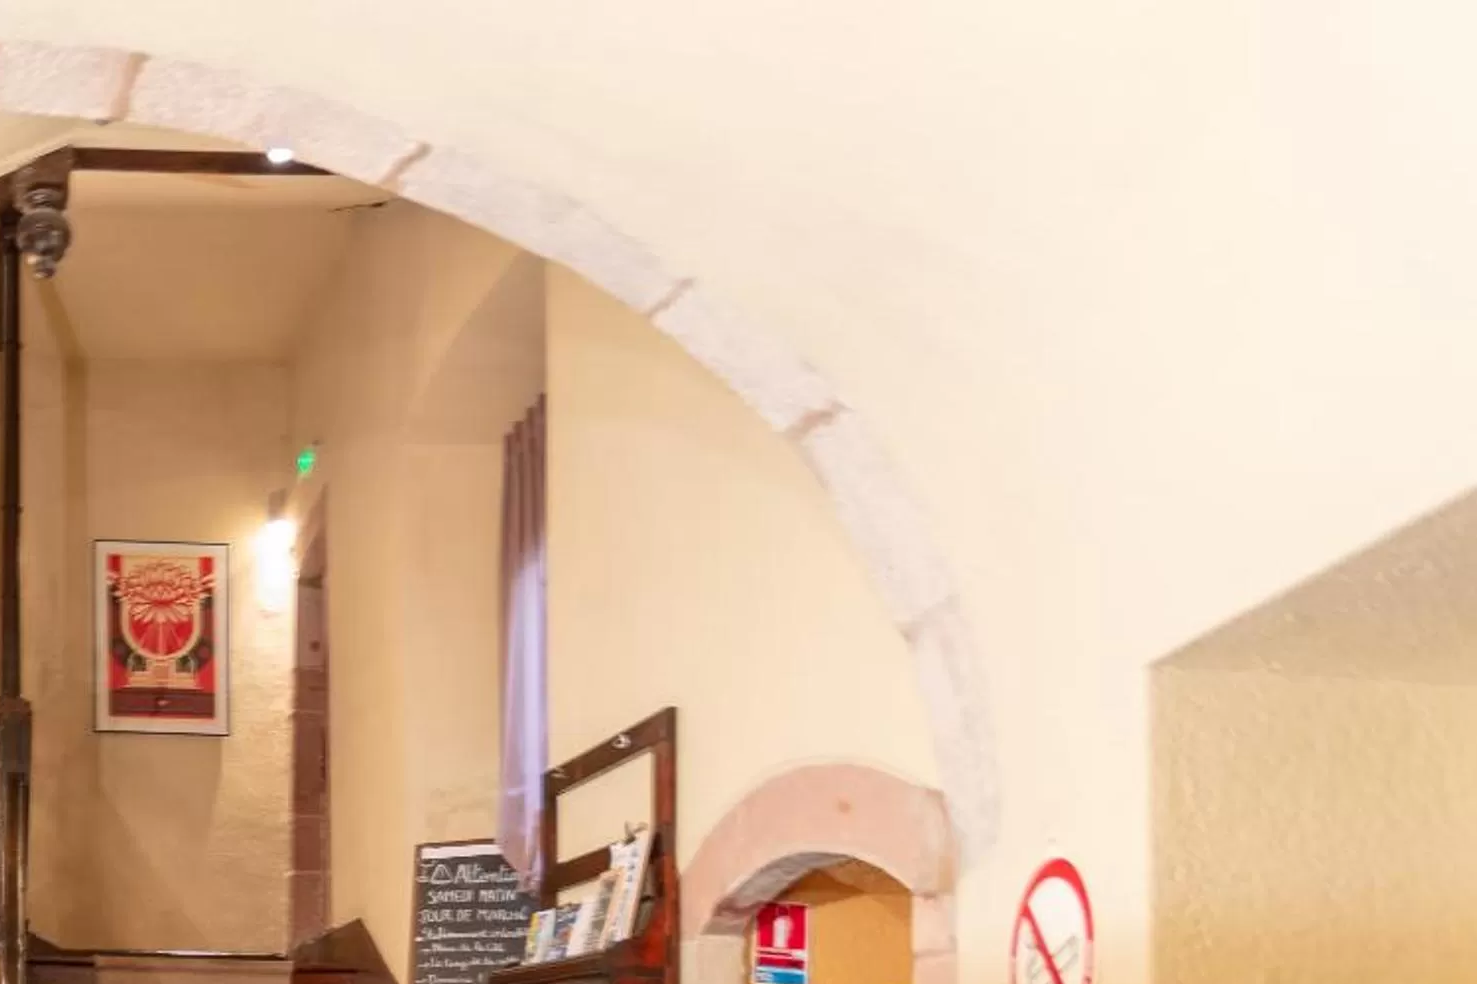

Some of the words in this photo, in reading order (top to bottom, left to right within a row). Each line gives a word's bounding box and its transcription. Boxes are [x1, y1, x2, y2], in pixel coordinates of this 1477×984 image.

[427, 889, 472, 905] SAMEDI
[478, 888, 517, 903] MATIN
[456, 908, 472, 923] DE
